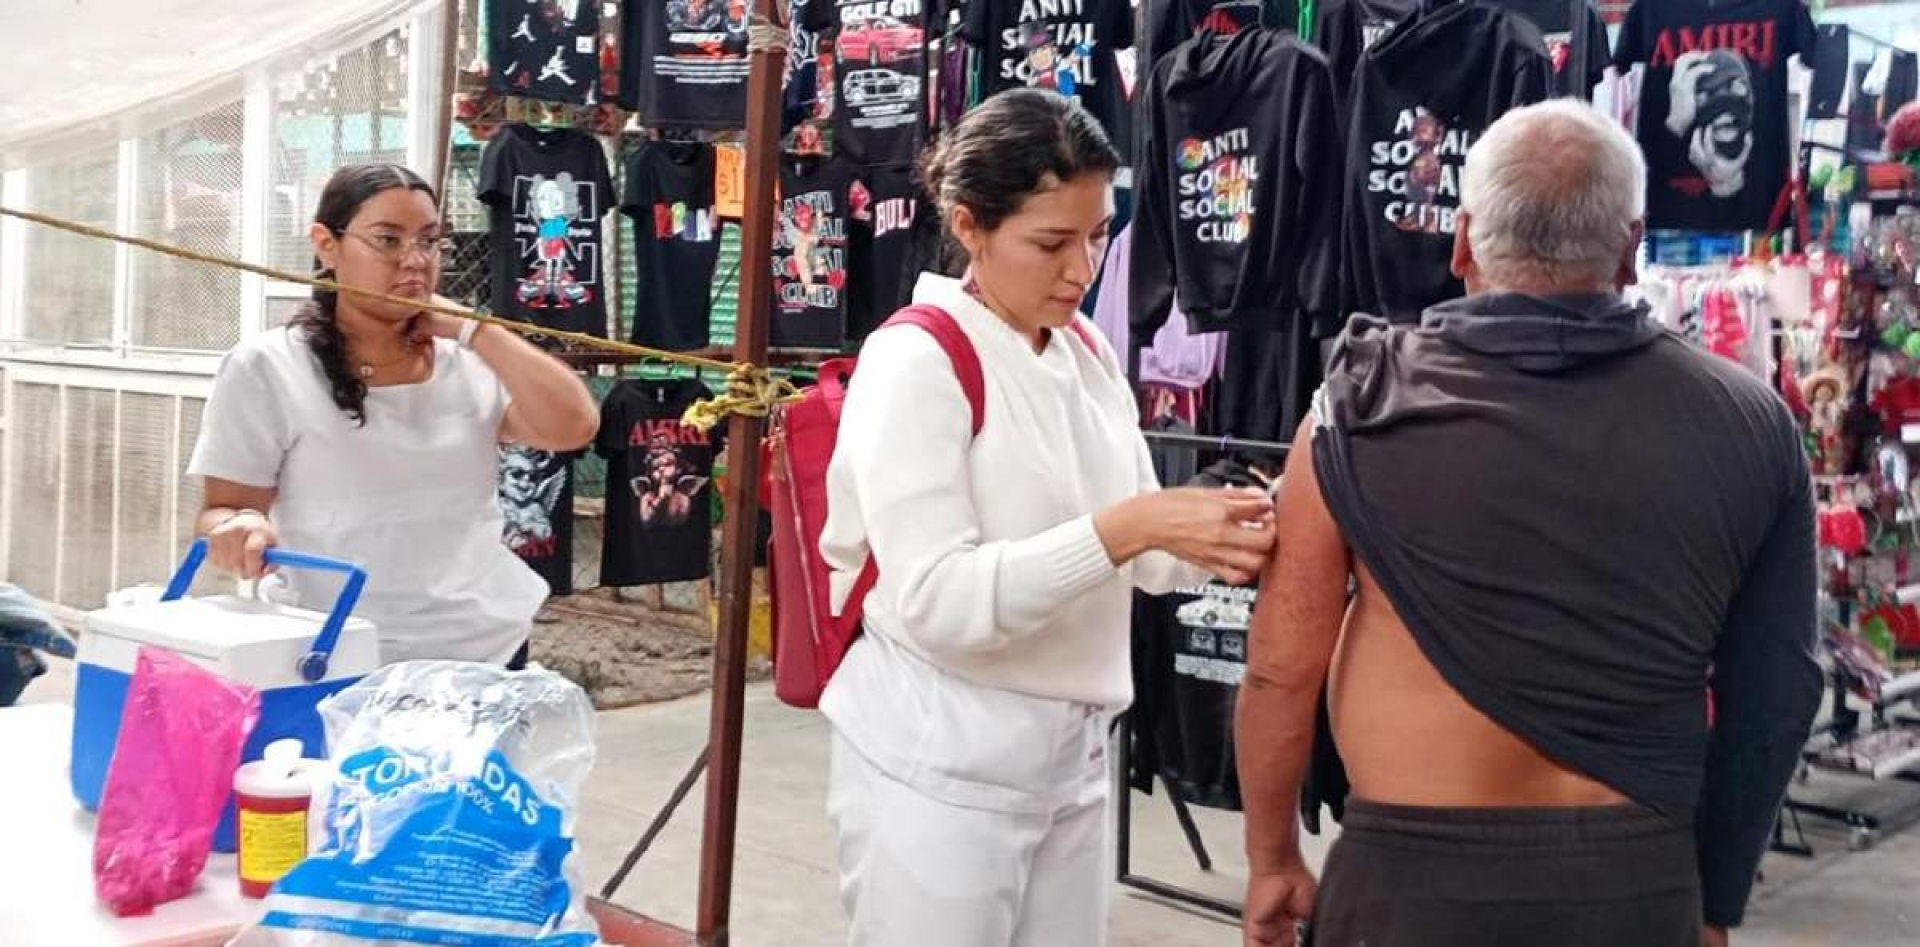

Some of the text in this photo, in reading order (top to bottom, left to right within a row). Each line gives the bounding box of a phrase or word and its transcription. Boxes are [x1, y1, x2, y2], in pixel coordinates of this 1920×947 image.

[1198, 128, 1249, 165] ANTI
[1179, 155, 1259, 195] SOCIAL
[1179, 189, 1256, 219] SOCIAL
